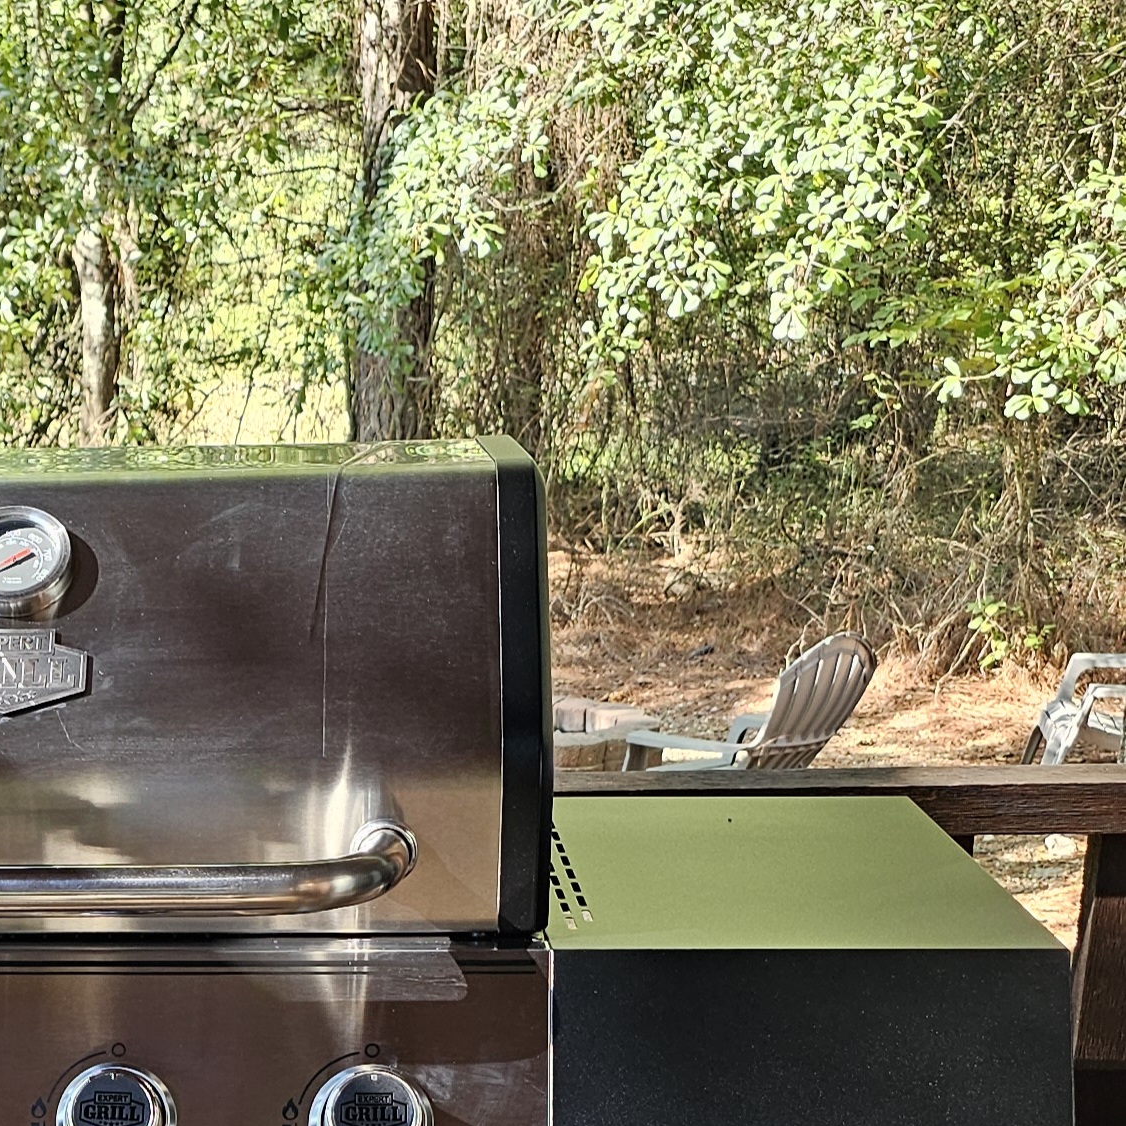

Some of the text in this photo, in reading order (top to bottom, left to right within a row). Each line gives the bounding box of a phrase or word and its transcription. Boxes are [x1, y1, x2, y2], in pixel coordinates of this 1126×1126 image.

[97, 1094, 128, 1102] EXPERT
[358, 1095, 390, 1103] EXPERT
[83, 1104, 140, 1121] GRILL
[345, 1106, 403, 1122] GRILL
